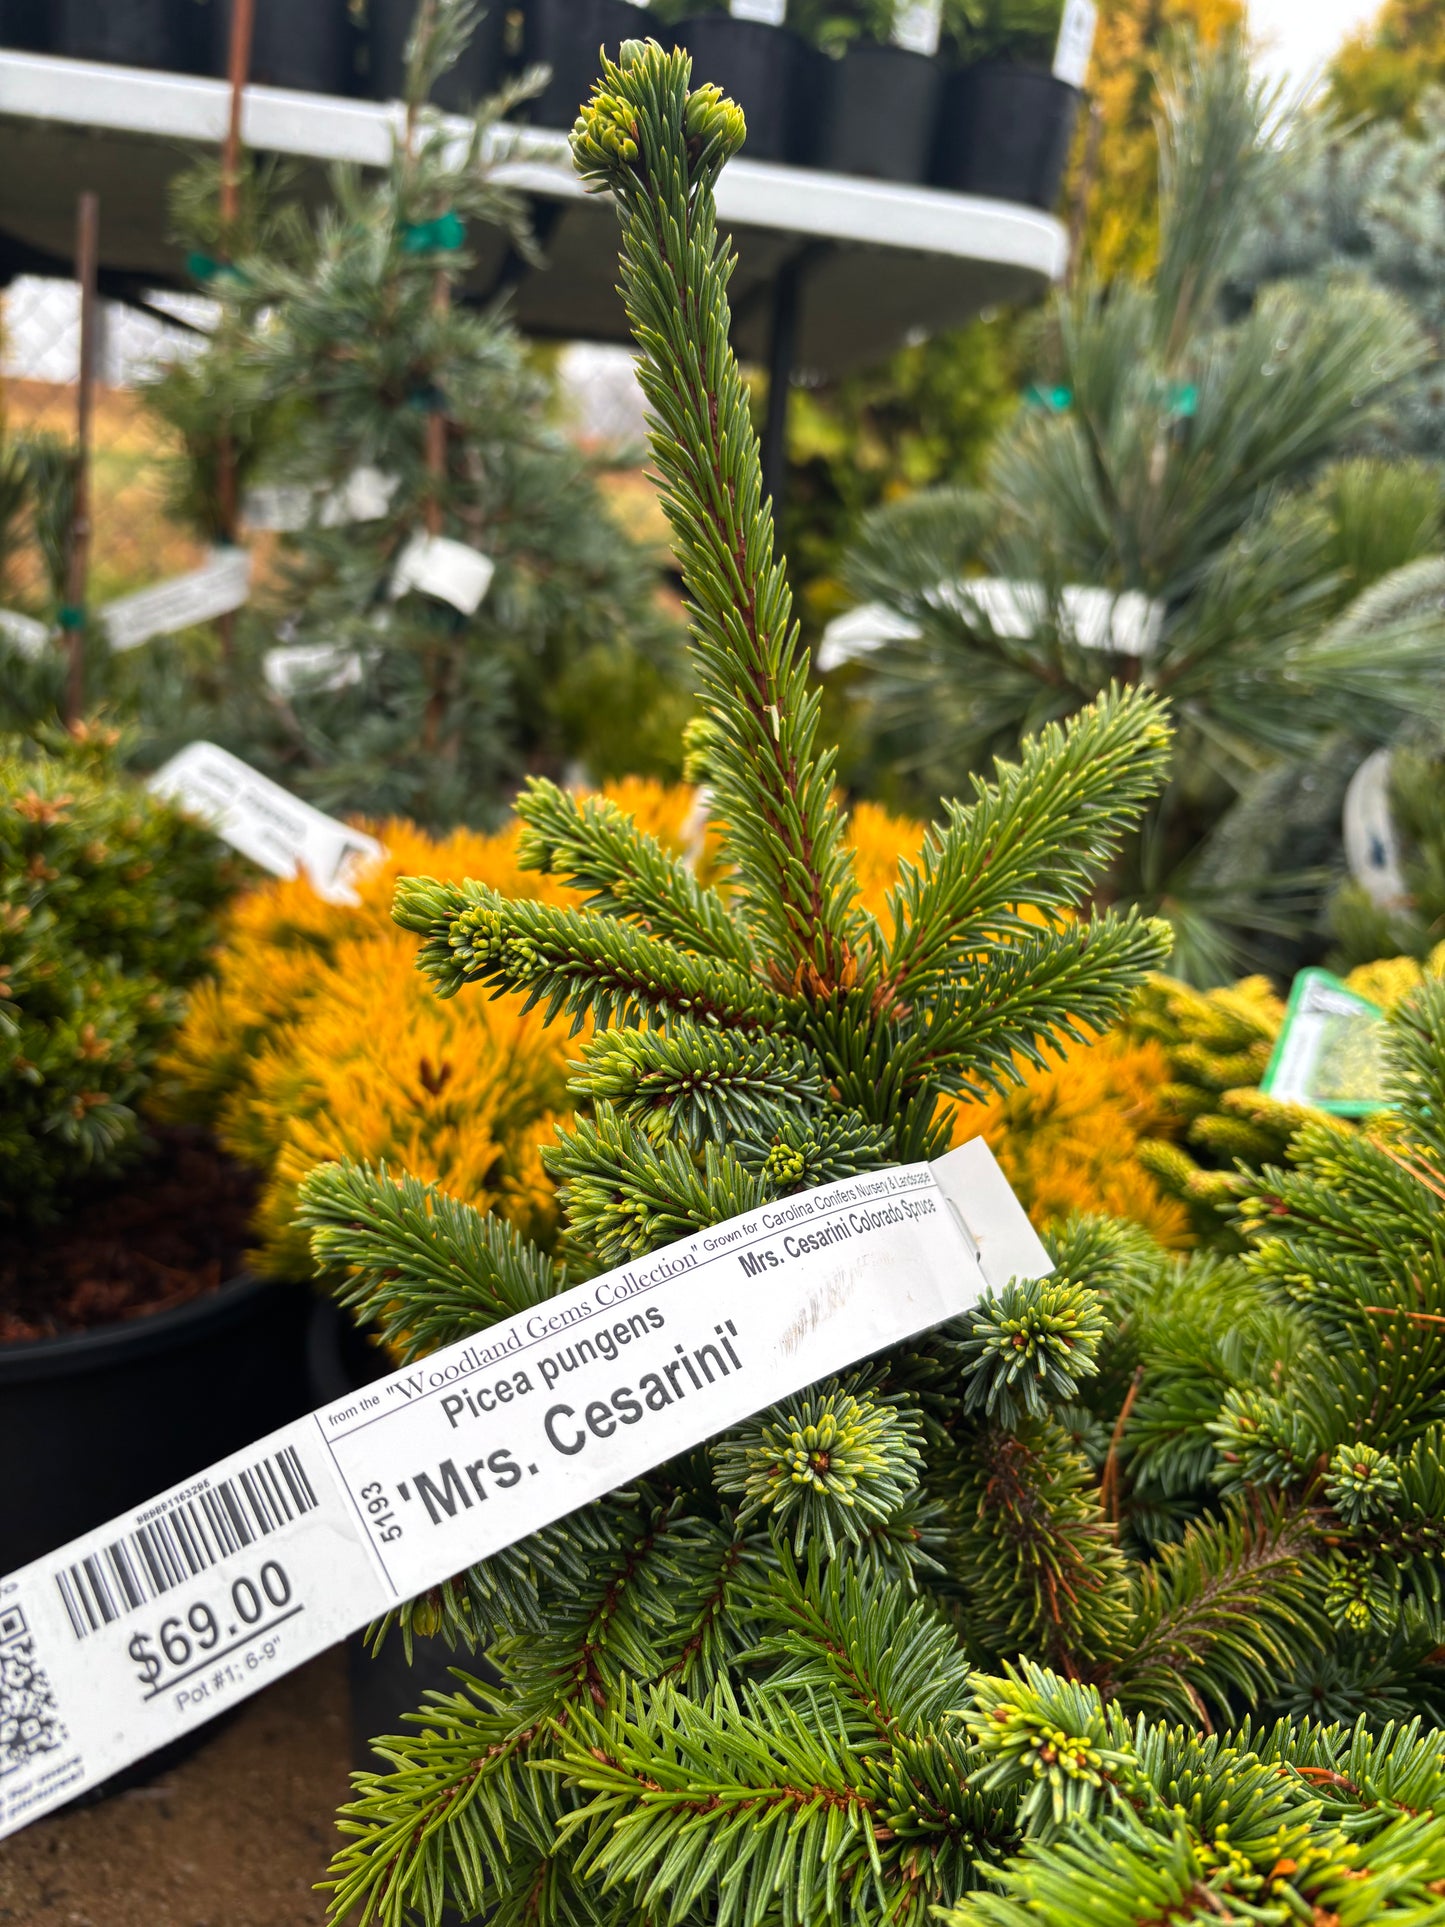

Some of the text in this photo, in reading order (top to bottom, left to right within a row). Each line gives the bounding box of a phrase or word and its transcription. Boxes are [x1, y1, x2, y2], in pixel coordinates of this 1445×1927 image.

[329, 1172, 931, 1426] from the "Woodland Gems Collection" Grown for Carolina Conifers Nursery & Landscape
[738, 1199, 937, 1278] Mrs. Cesarini Colorado Spruce
[397, 1318, 743, 1525] 'Mrs. Cesarini'
[440, 1306, 665, 1428] Picea pungens
[361, 1481, 402, 1543] 5193
[128, 1560, 292, 1692] $69.00
[175, 1682, 210, 1712] Pot
[213, 1664, 244, 1691] #1;
